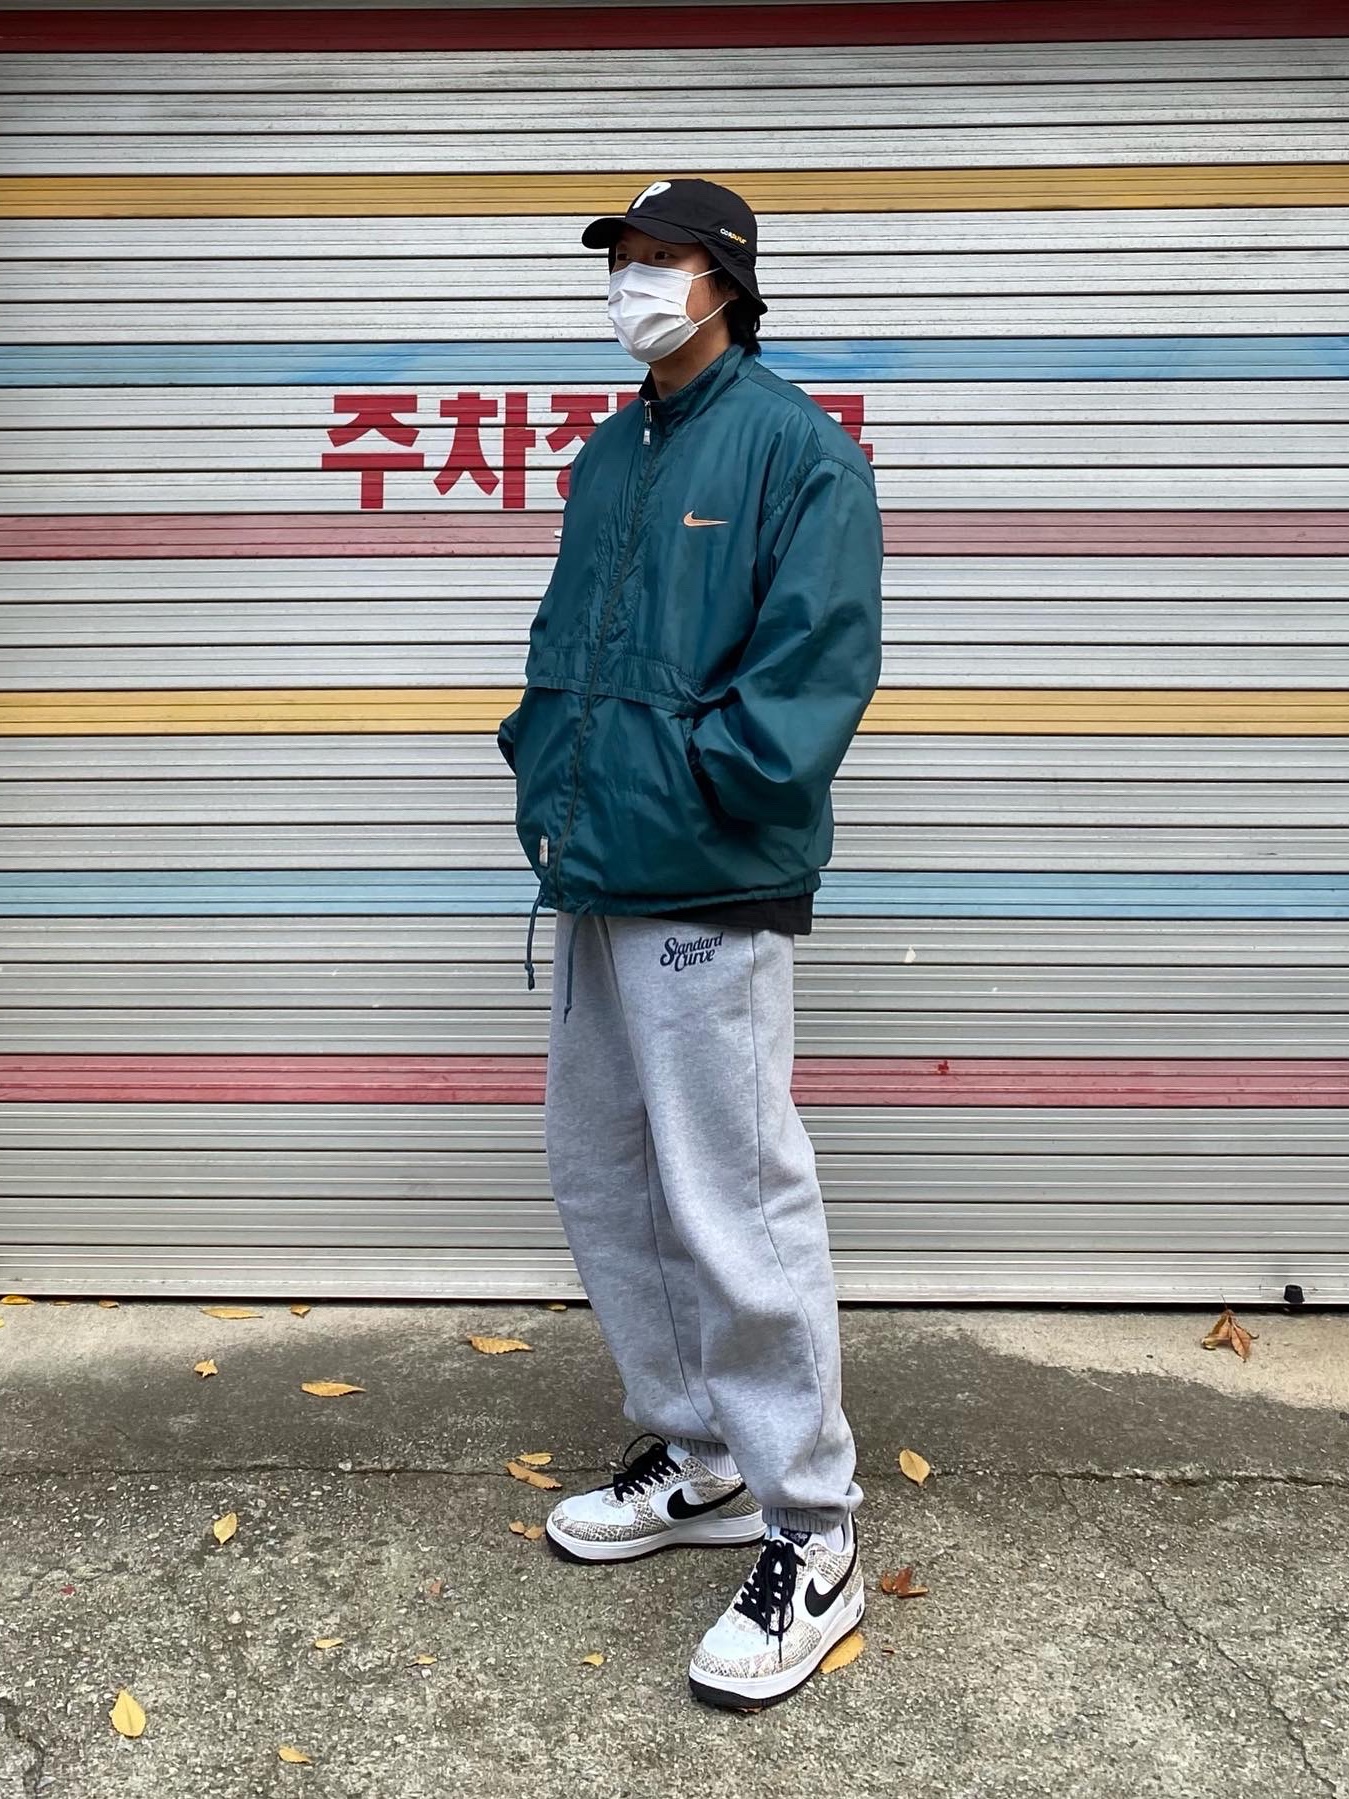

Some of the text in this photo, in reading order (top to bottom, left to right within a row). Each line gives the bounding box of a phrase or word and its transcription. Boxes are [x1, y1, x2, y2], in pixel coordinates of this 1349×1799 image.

[632, 181, 672, 209] P
[660, 931, 724, 966] Standard
[674, 949, 715, 972] Curve
